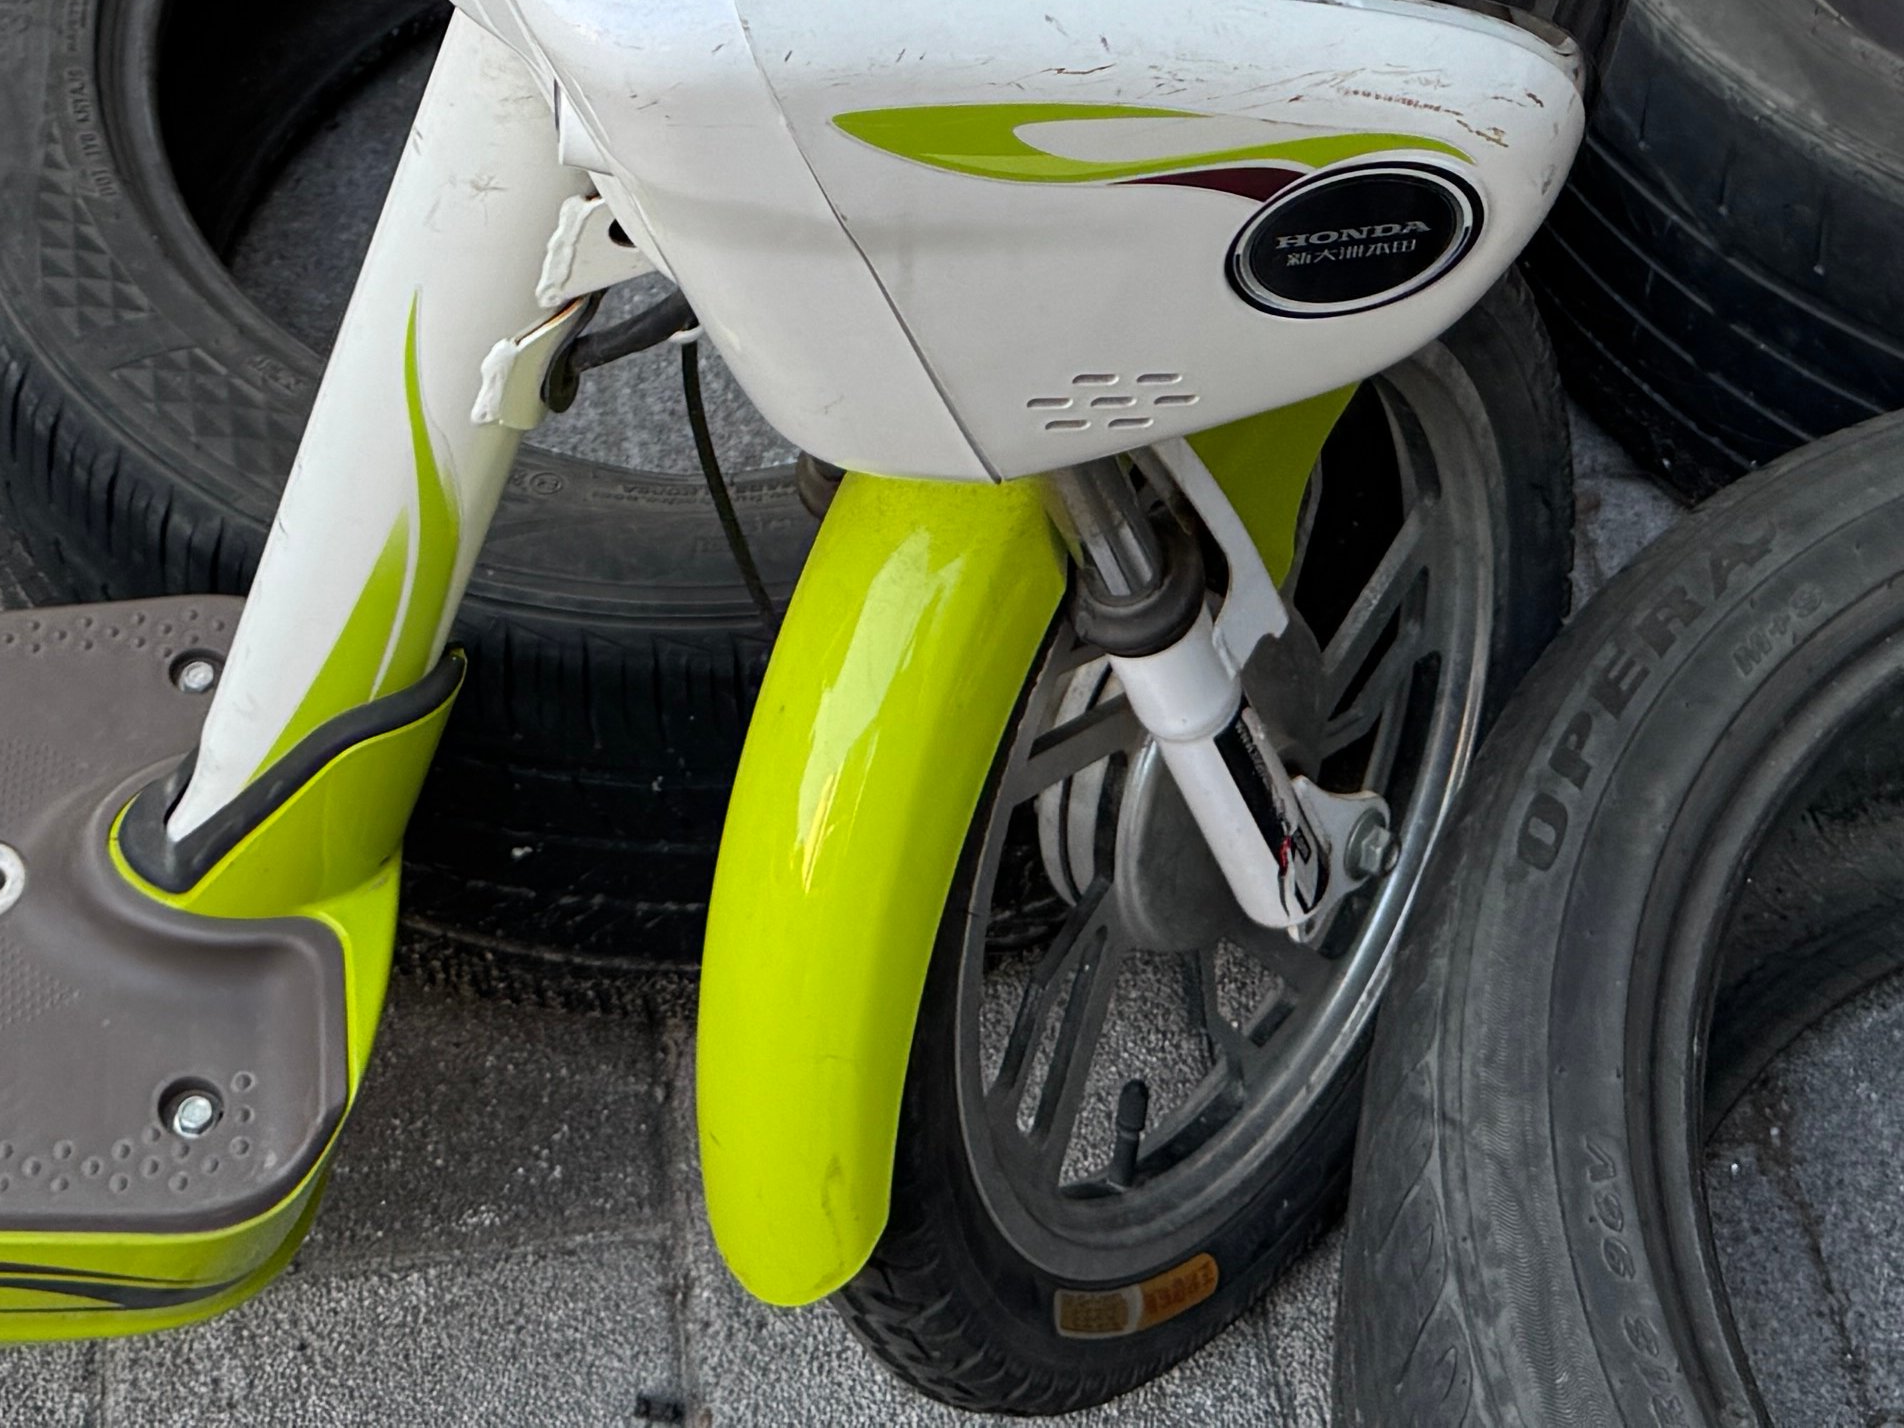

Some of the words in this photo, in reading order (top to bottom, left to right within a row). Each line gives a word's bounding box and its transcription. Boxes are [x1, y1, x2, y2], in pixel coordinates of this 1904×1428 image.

[1275, 220, 1433, 250] HONDA
[1729, 581, 1825, 677] M+S
[1513, 521, 1779, 874] OPERA
[1586, 1133, 1637, 1282] 96V
